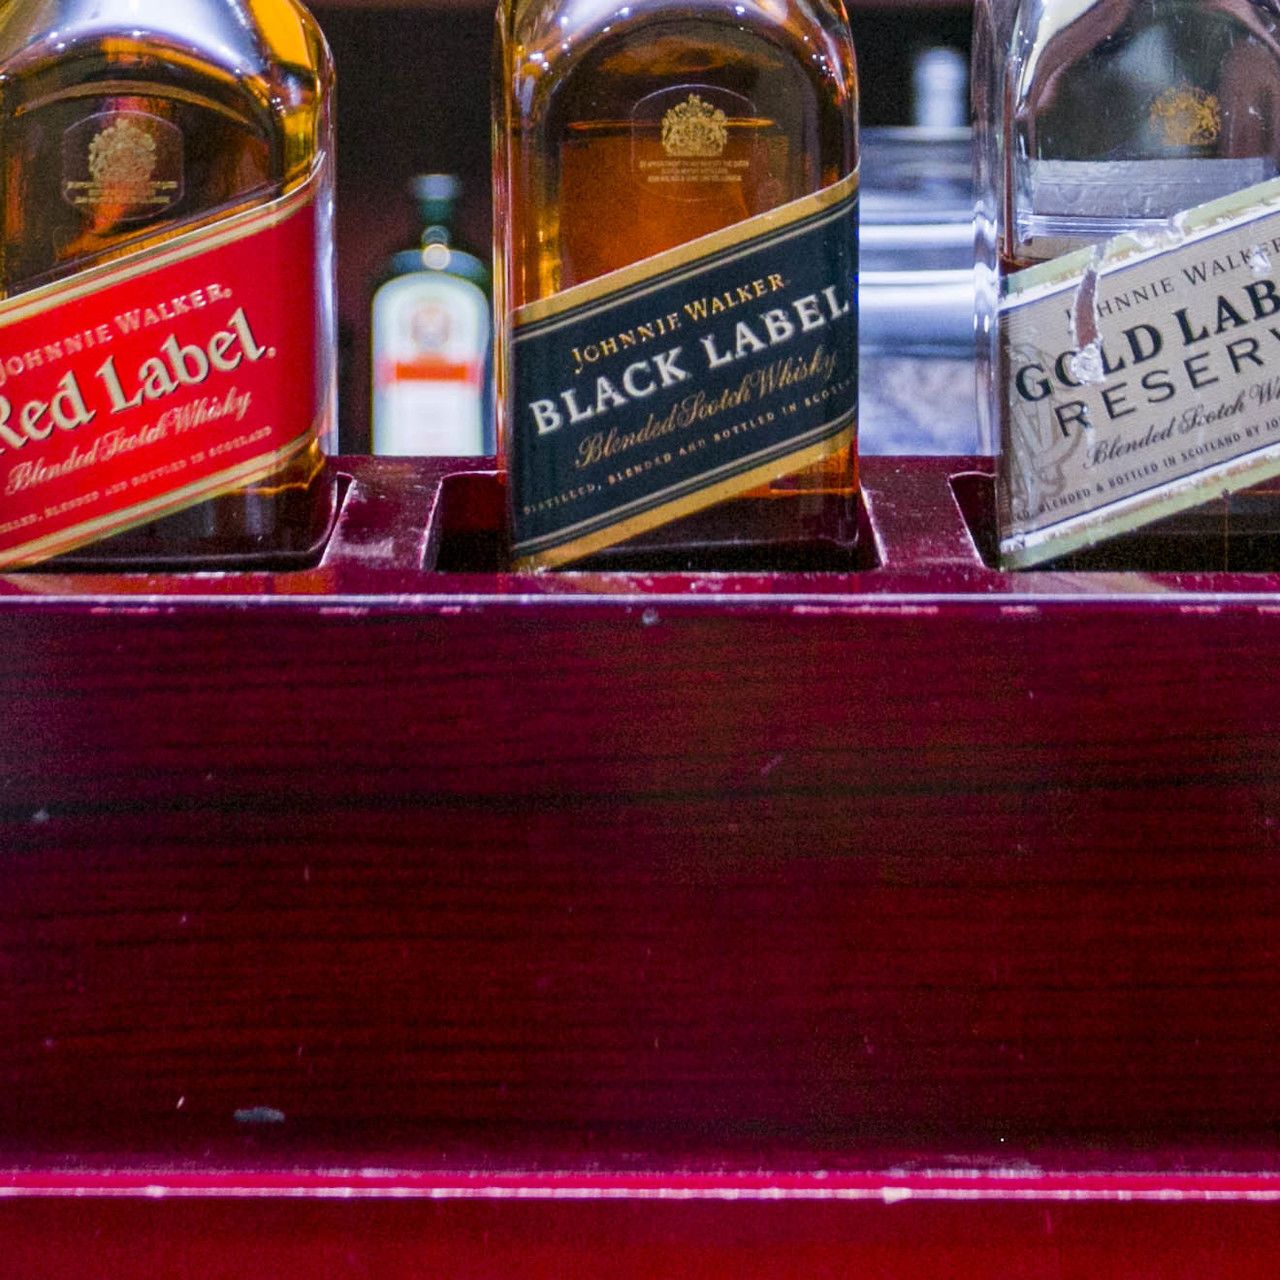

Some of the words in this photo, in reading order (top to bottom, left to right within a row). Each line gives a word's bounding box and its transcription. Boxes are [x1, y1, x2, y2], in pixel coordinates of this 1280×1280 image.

[528, 346, 691, 436] BLACK
[699, 284, 851, 369] LABEL
[571, 312, 683, 375] JOHNNIE
[683, 273, 786, 321] WALKER
[1015, 323, 1163, 402] GOLD
[4, 437, 103, 496] Blended
[99, 410, 169, 461] Scotch
[169, 386, 252, 435] Whisky
[574, 404, 677, 469] Blended
[676, 374, 752, 428] Scotch
[750, 344, 839, 399] Whisky
[607, 452, 672, 486] BLENDED
[678, 437, 707, 457] AND
[713, 412, 775, 443] BOTTLED
[781, 402, 798, 417] IN
[1082, 416, 1176, 470] Blended
[1177, 389, 1246, 436] Scotch
[1108, 462, 1159, 488] BOTTLED
[1162, 456, 1177, 468] IN
[1181, 433, 1241, 463] SCOTLAND
[1246, 424, 1261, 437] BY
